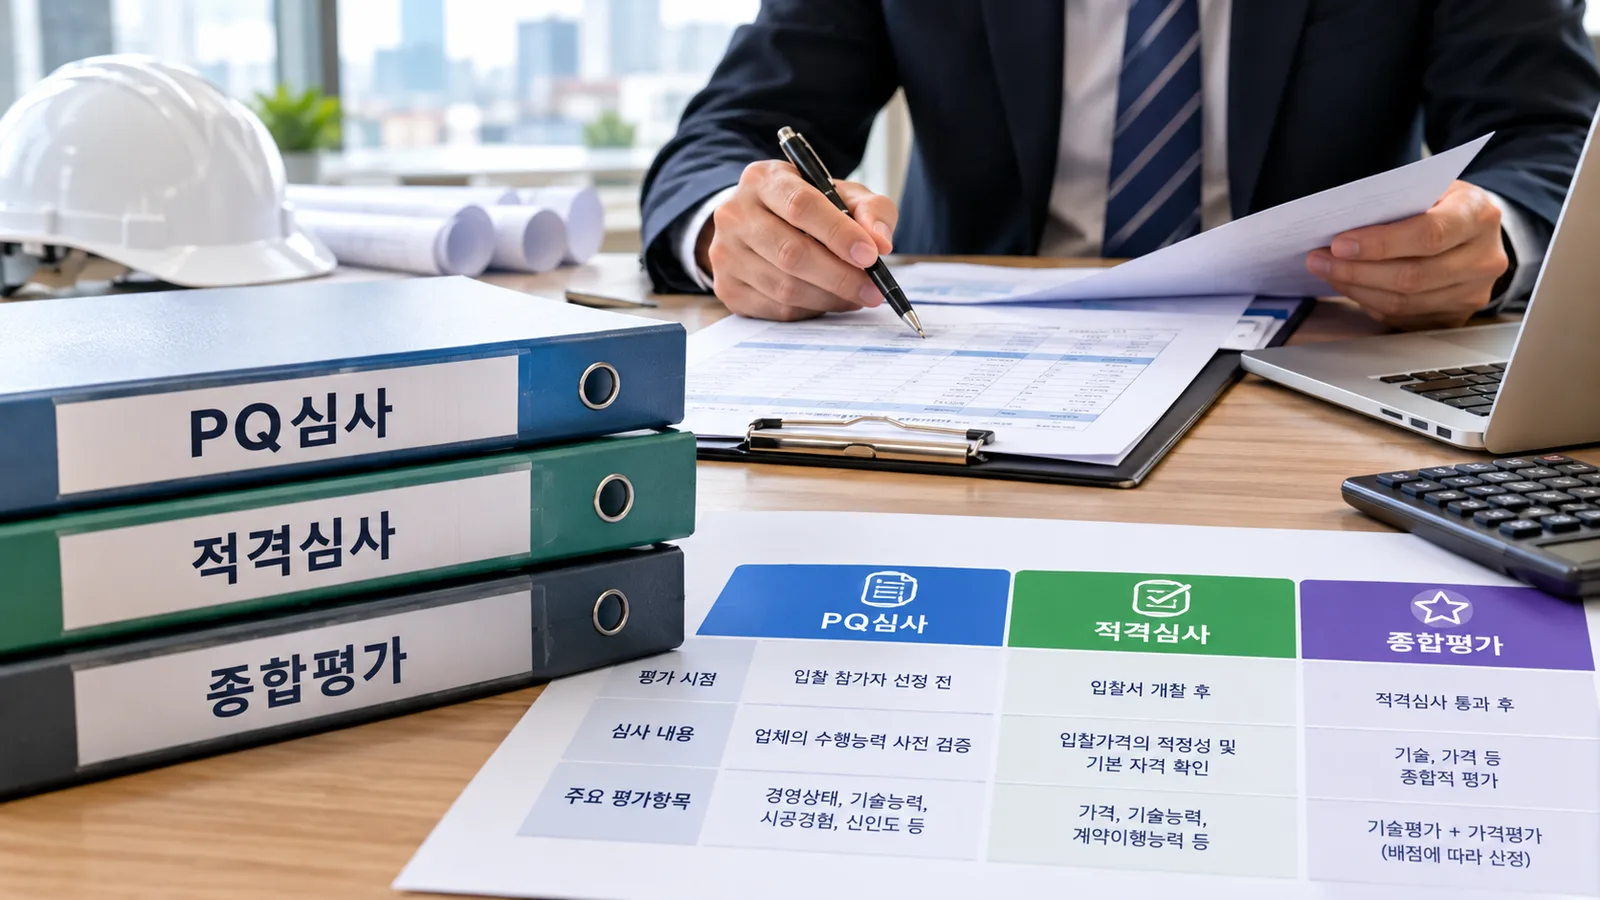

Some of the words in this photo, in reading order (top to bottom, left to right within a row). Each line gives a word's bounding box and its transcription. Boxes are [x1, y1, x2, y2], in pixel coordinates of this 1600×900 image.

[191, 388, 392, 457] PQ심사
[192, 511, 395, 585] 적격심사
[820, 612, 929, 634] PQ심사
[1094, 621, 1211, 645] 적격심사
[1386, 631, 1504, 657] 종합평가
[207, 636, 407, 718] 종합평가
[638, 669, 676, 686] 평가
[679, 671, 717, 687] 시점
[794, 669, 829, 685] 입찰
[835, 670, 888, 688] 참가자
[893, 673, 928, 689] 선정
[935, 675, 952, 690] 전
[1090, 680, 1143, 697] 입찰서
[1151, 682, 1187, 699] 개찰
[1193, 684, 1211, 700] 후
[1375, 692, 1448, 711] 적격심사
[1454, 695, 1490, 713] 통과
[1497, 697, 1515, 713] 후
[612, 723, 651, 741] 심사
[656, 725, 695, 743] 내용
[755, 728, 808, 746] 업체의
[814, 731, 887, 750] 수행능력
[892, 735, 929, 752] 사전
[936, 737, 972, 754] 검증
[1060, 732, 1150, 752] 입찰가격의
[1157, 736, 1211, 754] 적정성
[1219, 739, 1236, 756] 및
[1086, 755, 1123, 773] 기본
[1129, 757, 1165, 775] 자격
[1173, 758, 1209, 777] 확인
[1394, 746, 1435, 765] 기술,
[1442, 748, 1477, 766] 가격
[1484, 750, 1502, 767] 등
[1400, 768, 1454, 788] 종합적
[1461, 771, 1499, 790] 평가
[564, 787, 605, 805] 주요
[611, 789, 691, 811] 평가항목
[765, 787, 843, 808] 경영상태,
[850, 791, 928, 813] 기술능력,
[760, 810, 838, 832] 시공경험,
[846, 814, 900, 833] 신인도
[907, 817, 925, 835] 등
[1079, 804, 1120, 824] 가격,
[1128, 806, 1207, 829] 기술능력,
[1072, 827, 1183, 850] 계약이행능력
[1191, 833, 1210, 851] 등
[1368, 819, 1442, 840] 기술평가
[1468, 824, 1543, 845] 가격평가
[1381, 843, 1441, 864] (배점에
[1447, 847, 1483, 866] 따라
[1489, 849, 1531, 869] 산정)
